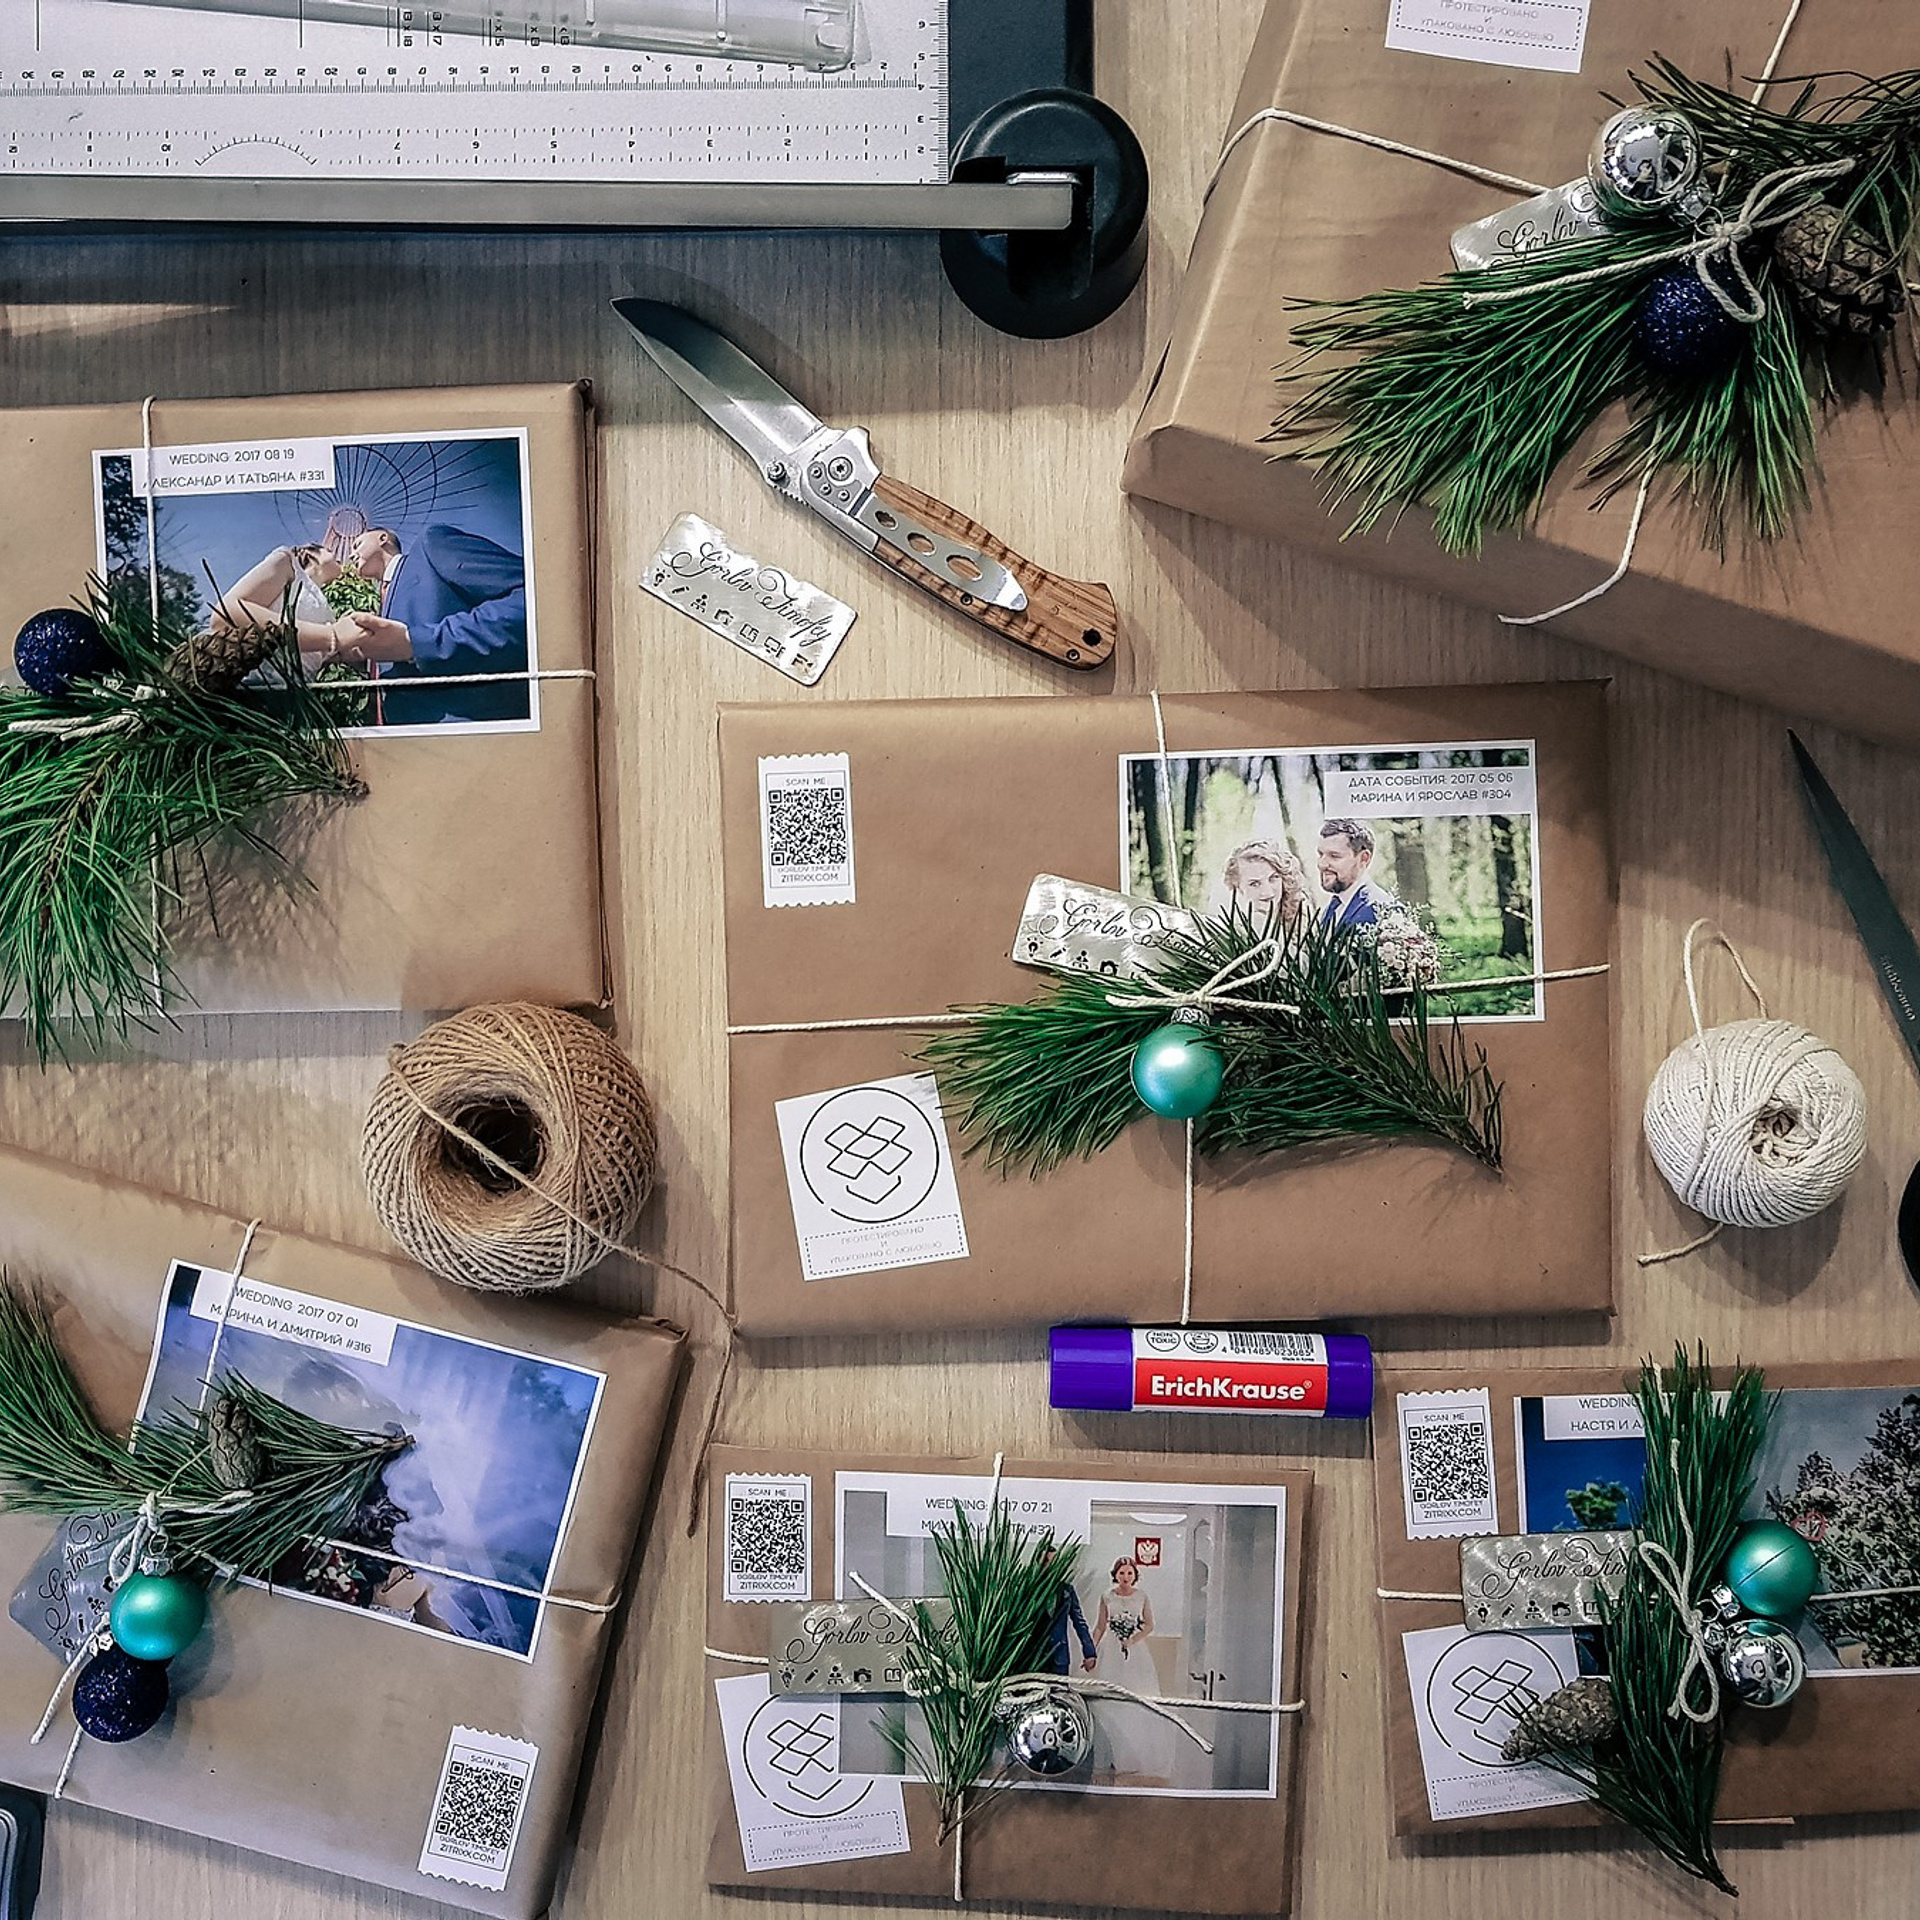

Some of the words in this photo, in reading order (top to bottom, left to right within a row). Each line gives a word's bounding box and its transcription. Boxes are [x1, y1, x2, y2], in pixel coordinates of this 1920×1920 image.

[918, 20, 926, 29] 6
[917, 52, 926, 61] 5
[917, 83, 925, 91] 4
[917, 115, 925, 124] 3
[917, 146, 925, 154] 2
[234, 451, 261, 463] 2017
[264, 449, 281, 461] 08
[283, 448, 295, 460] 19
[225, 474, 237, 485] И
[238, 471, 297, 486] ТАТЬЯНА
[299, 470, 326, 483] #331
[659, 541, 754, 593] Gorlov
[785, 778, 810, 787] SCAN
[813, 776, 827, 786] ME
[1348, 776, 1383, 789] ДАТА
[1450, 773, 1476, 785] 2017
[1478, 772, 1495, 784] 05
[1497, 771, 1514, 784] 06
[1350, 792, 1402, 805] МАРИНА
[1404, 791, 1416, 803] И
[1418, 789, 1479, 802] ЯРОСЛАВ
[1481, 788, 1512, 800] #304
[234, 1287, 294, 1312] WEDDING
[297, 1303, 325, 1319] 2017
[327, 1311, 343, 1324] 07
[345, 1316, 359, 1329] 01
[267, 1319, 278, 1331] И
[279, 1321, 342, 1346] ДМИТРИЙ
[345, 1339, 373, 1354] #316
[1150, 1336, 1177, 1344] TOXIC
[1221, 1346, 1228, 1354] 4
[1424, 1413, 1449, 1422] SCAN
[1452, 1412, 1466, 1421] ME
[1570, 1419, 1616, 1432] НАСТЯ
[1618, 1419, 1630, 1431] И
[747, 1488, 771, 1496] SCAN
[775, 1489, 787, 1497] ME
[1021, 1501, 1038, 1513] 07
[1041, 1502, 1053, 1513] 21
[1474, 1551, 1568, 1600] Gorlov
[778, 1616, 872, 1664] Gorlov
[470, 1754, 495, 1767] SCAN
[497, 1760, 510, 1771] ME
